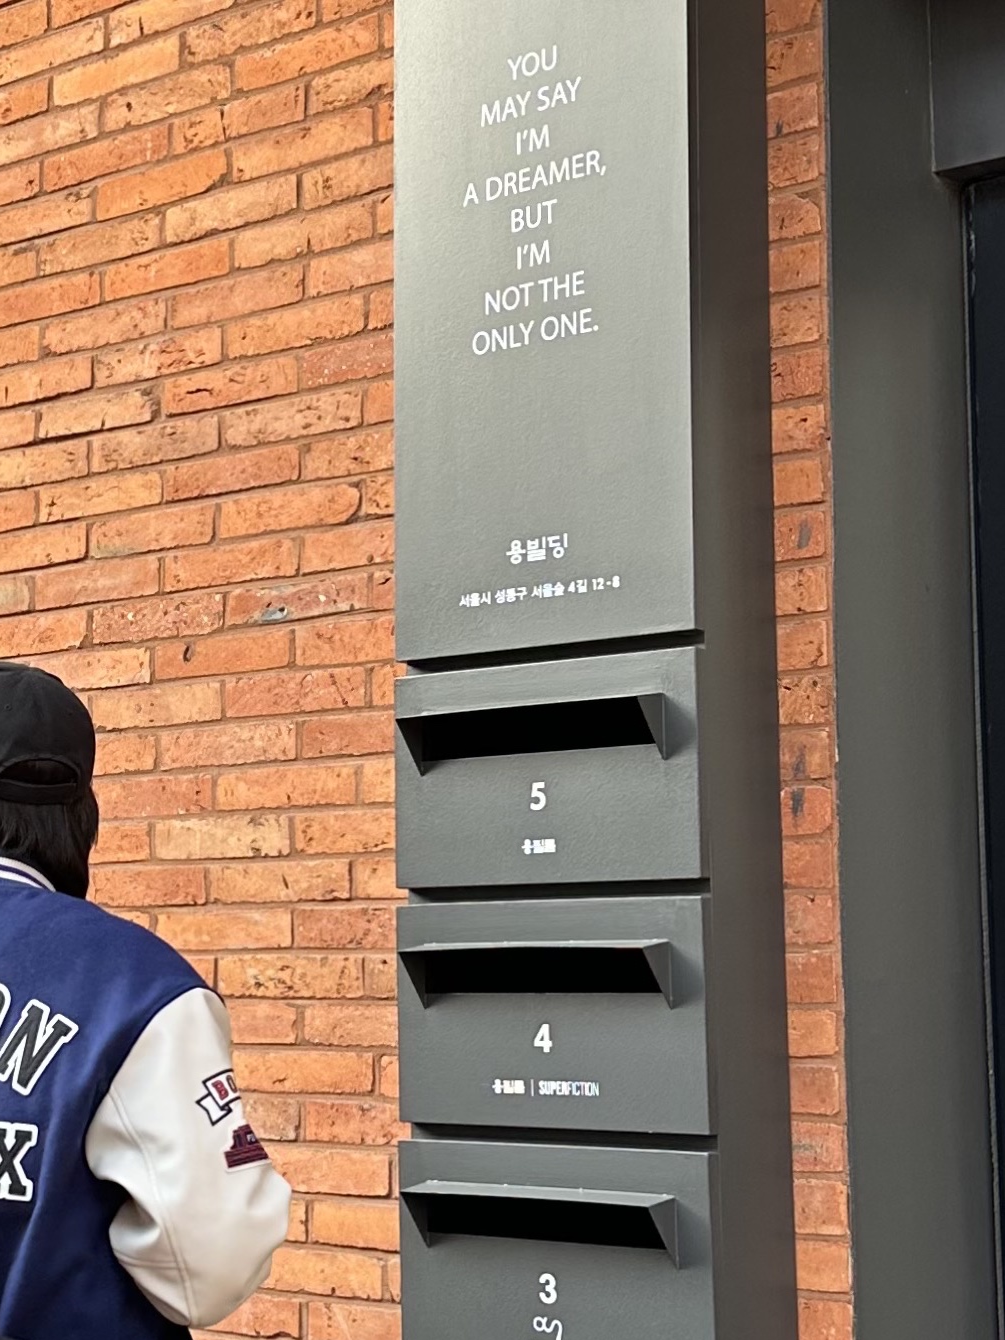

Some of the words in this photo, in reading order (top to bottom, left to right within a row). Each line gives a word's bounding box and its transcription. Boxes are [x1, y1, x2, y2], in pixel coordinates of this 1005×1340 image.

[507, 45, 557, 81] YOU
[480, 90, 531, 127] MAY
[537, 76, 582, 112] SAY
[463, 182, 479, 208] A
[485, 150, 606, 201] DREAMER,
[510, 198, 558, 233] BUT
[485, 281, 535, 316] NOT
[537, 270, 585, 303] THE
[472, 320, 535, 356] ONLY
[540, 307, 599, 341] ONE.
[506, 533, 568, 564] 용빌딩
[459, 591, 491, 608] 서울시
[530, 781, 547, 811] 5
[533, 1023, 553, 1053] 4
[538, 1273, 558, 1305] 3
